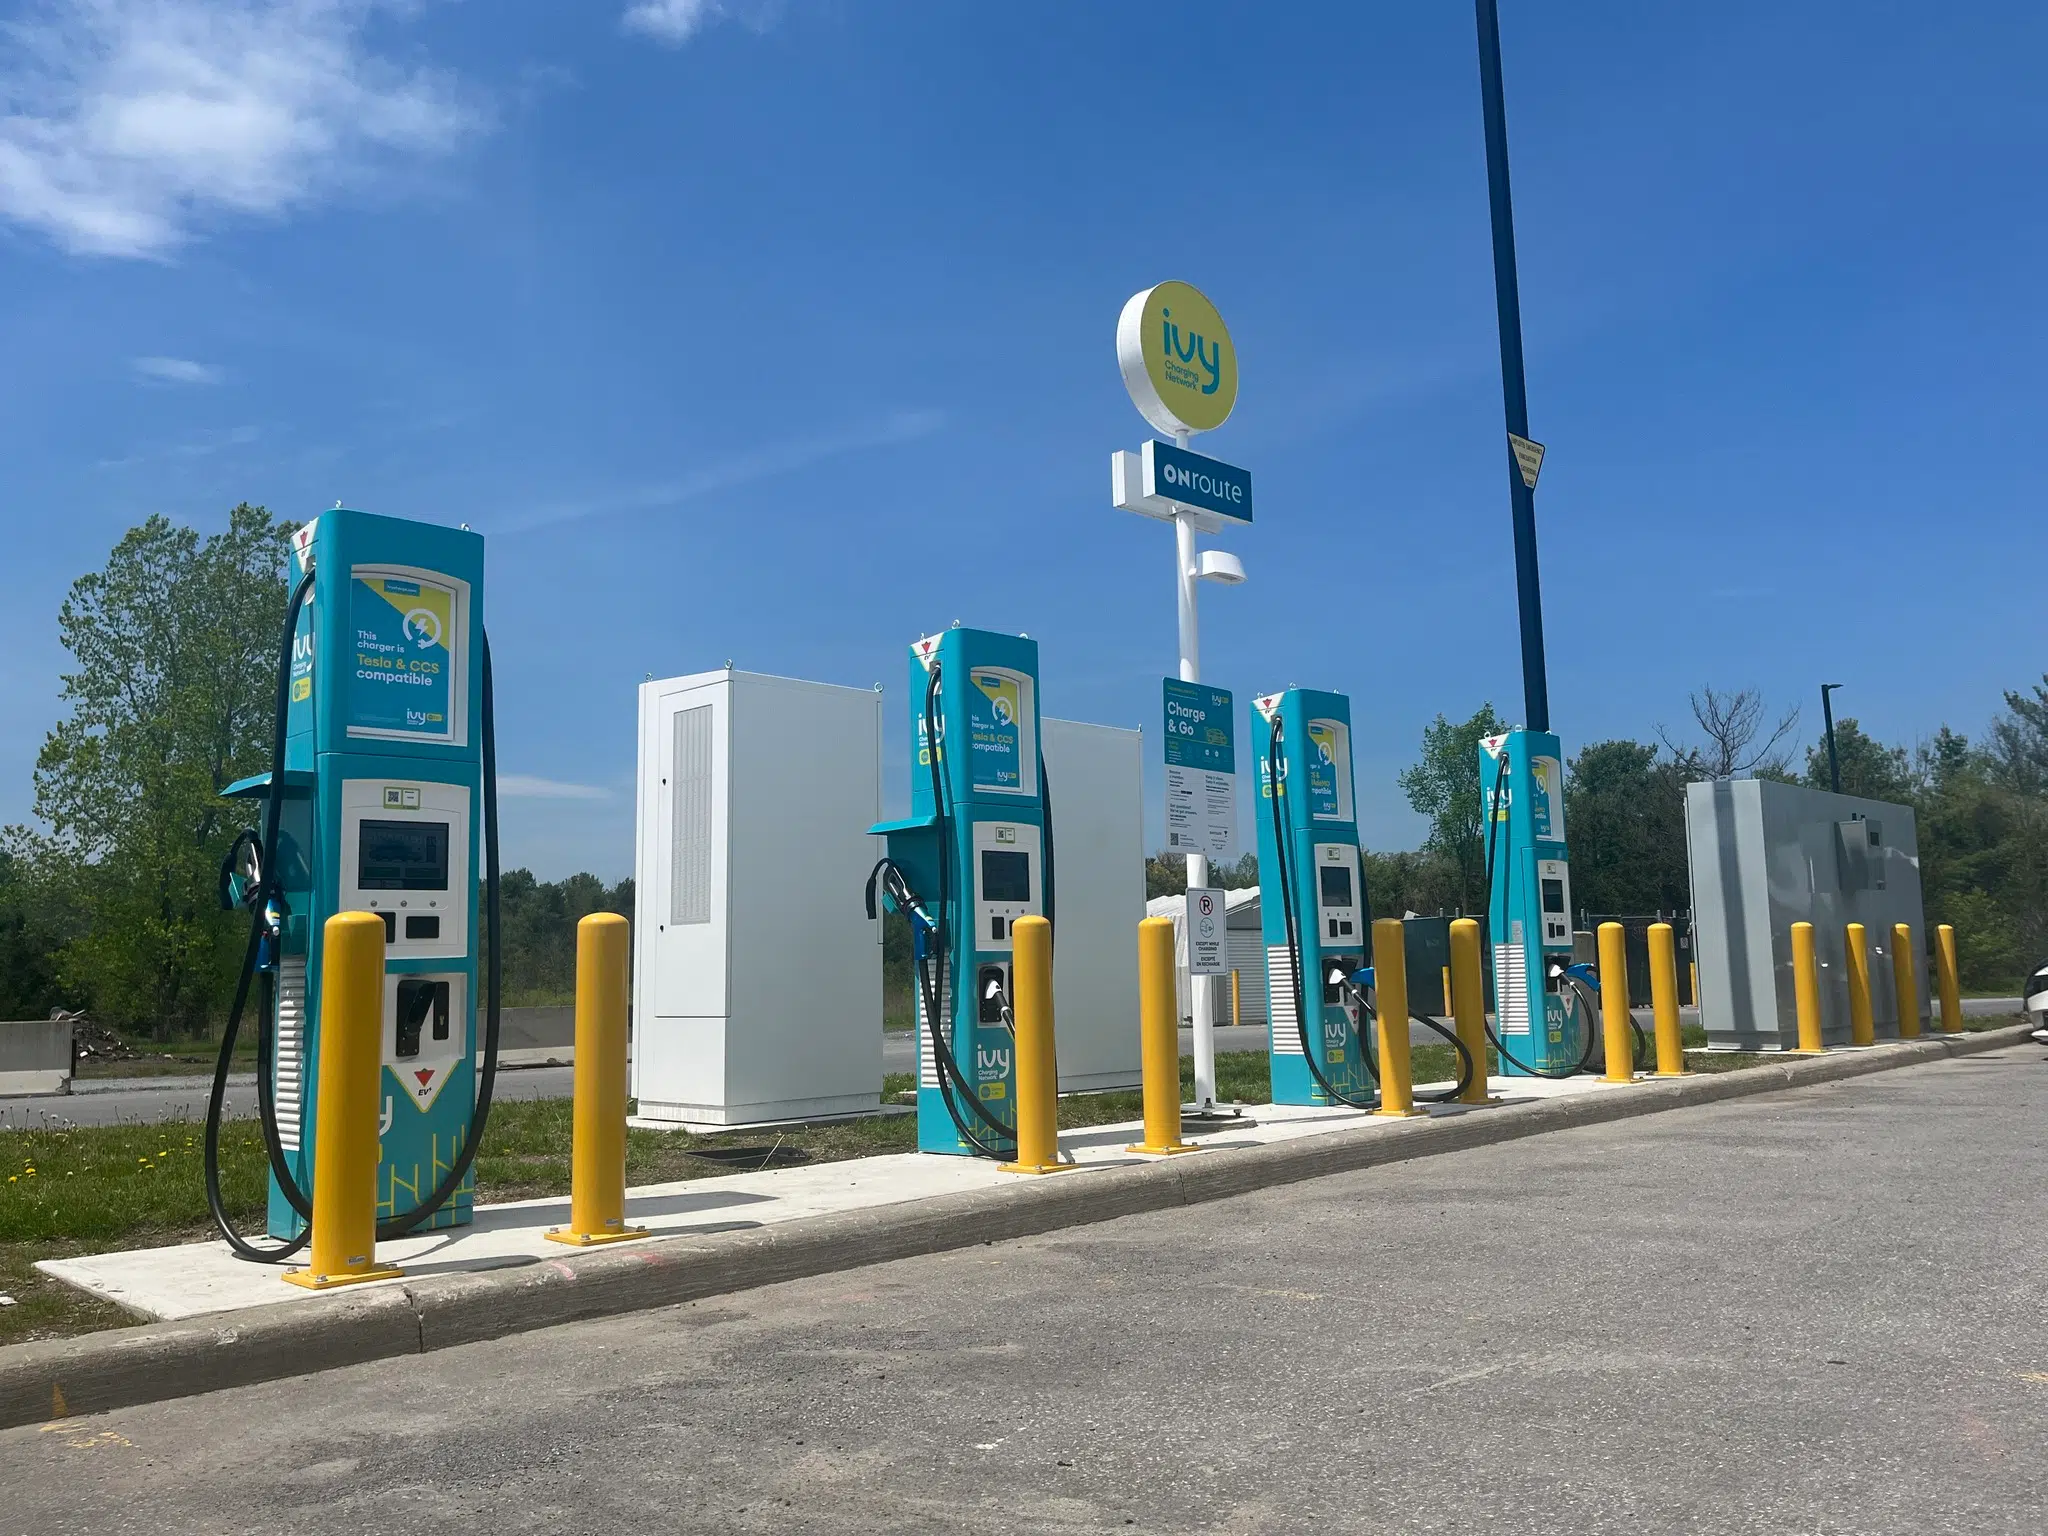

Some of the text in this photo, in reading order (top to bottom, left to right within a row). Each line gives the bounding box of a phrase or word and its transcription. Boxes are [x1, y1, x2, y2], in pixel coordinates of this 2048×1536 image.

[1163, 308, 1220, 395] ivy
[1165, 360, 1198, 383] Charging
[1165, 371, 1198, 391] Network
[1163, 464, 1242, 504] ONroute
[357, 630, 377, 640] This
[357, 640, 404, 653] charger is
[356, 653, 439, 674] Tesla & CCS
[356, 669, 432, 686] compatible
[406, 708, 425, 725] ivy
[1167, 701, 1205, 723] Charge
[971, 721, 989, 730] harger
[1168, 719, 1194, 736] & Go
[972, 732, 988, 741] esla
[997, 735, 1013, 744] CCS
[1547, 1006, 1563, 1029] ivy
[1325, 1019, 1347, 1047] ivy
[977, 1043, 1010, 1079] ivy
